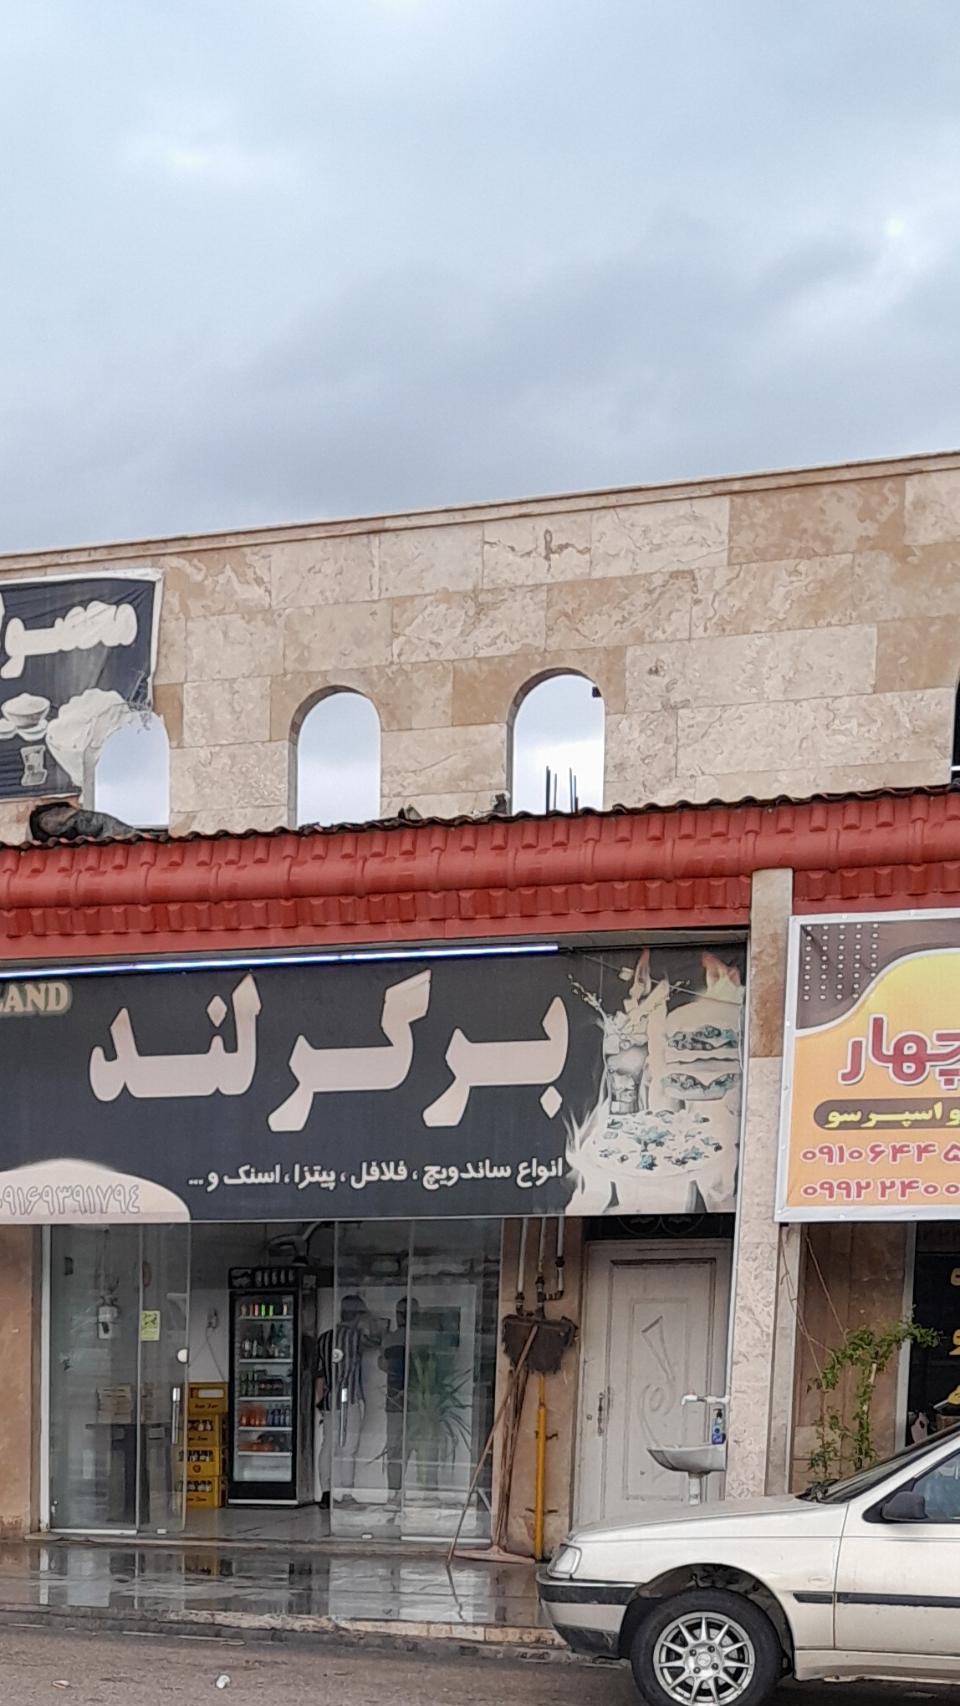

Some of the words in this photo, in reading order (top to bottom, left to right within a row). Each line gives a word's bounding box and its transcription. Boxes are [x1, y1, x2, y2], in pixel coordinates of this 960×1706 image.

[89, 973, 262, 1102] لند
[267, 968, 570, 1132] برگر
[224, 1164, 281, 1185] اسنک
[516, 1157, 563, 1188] انواع
